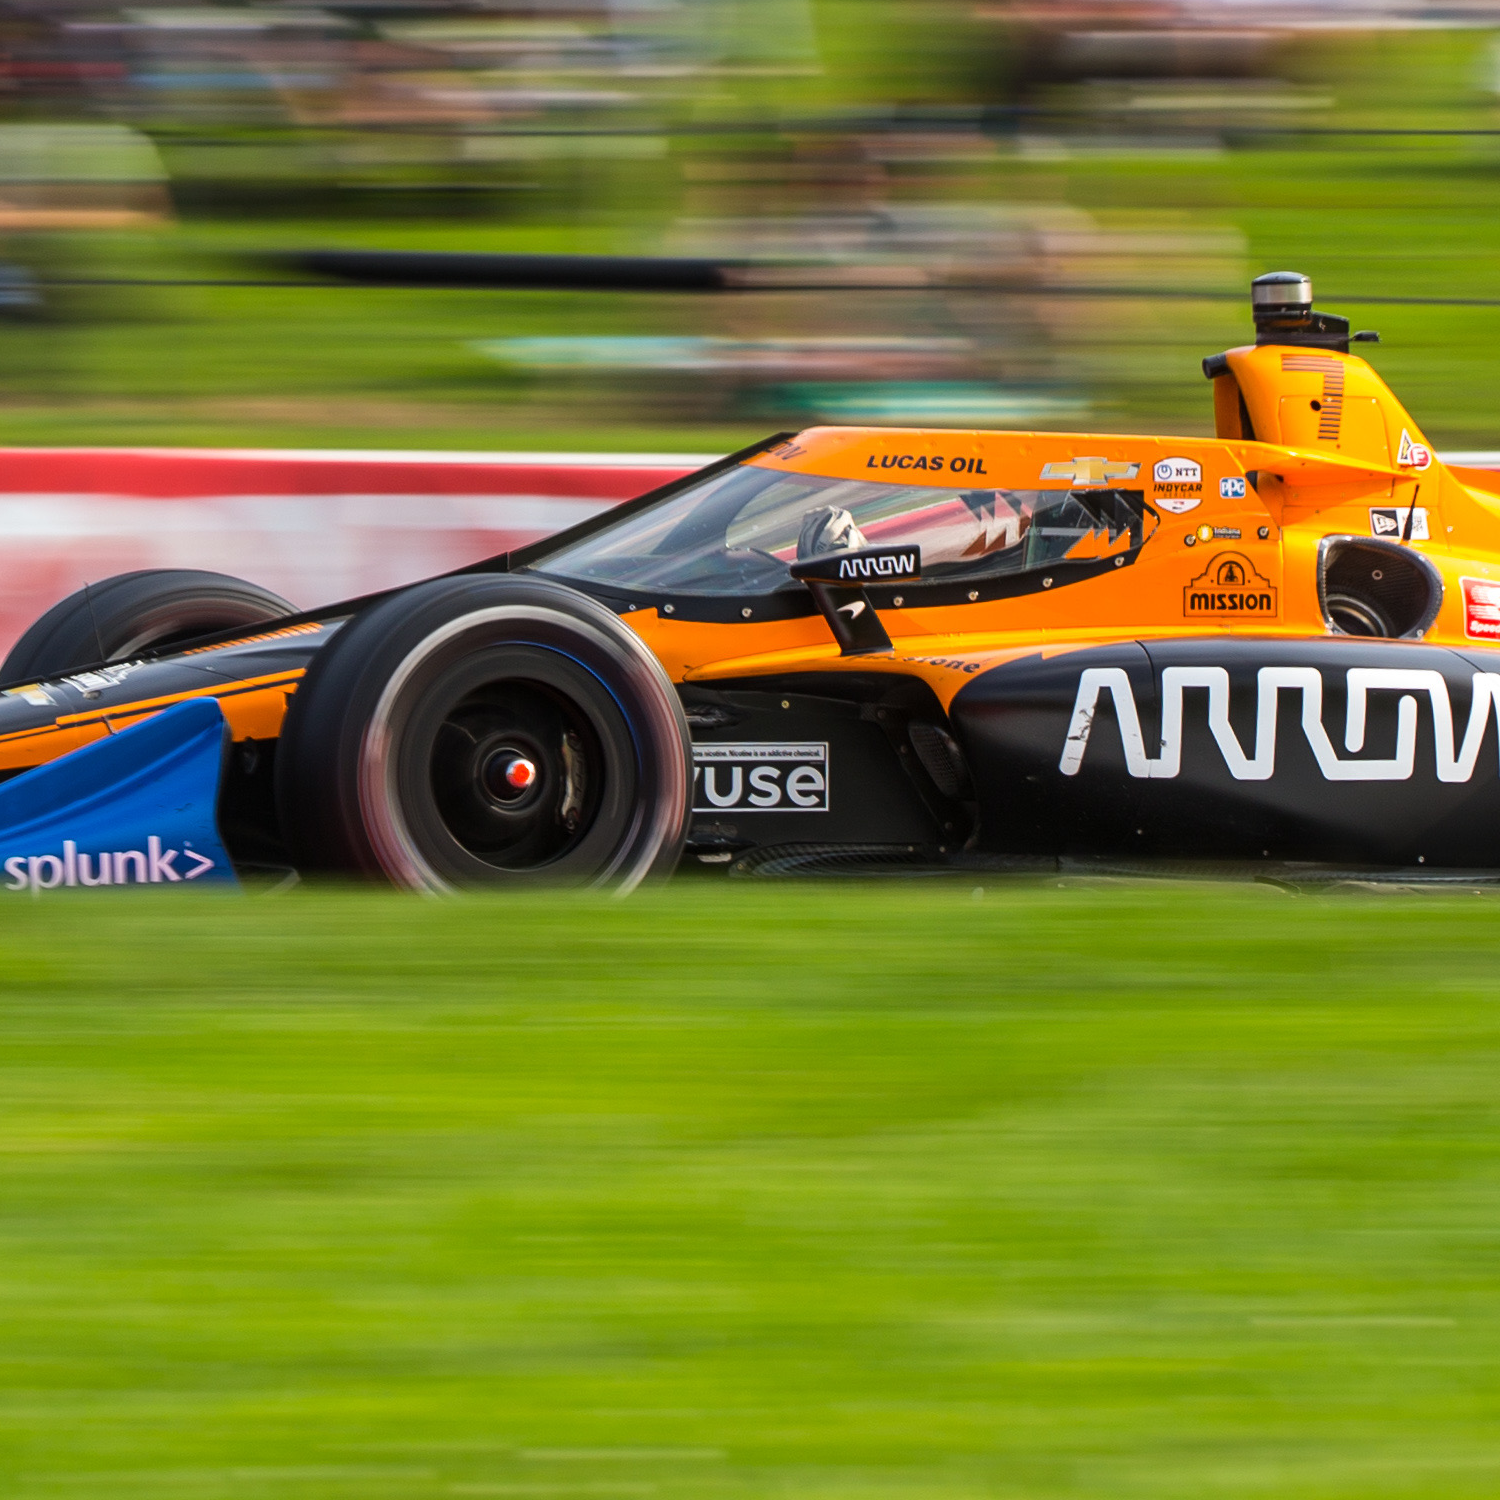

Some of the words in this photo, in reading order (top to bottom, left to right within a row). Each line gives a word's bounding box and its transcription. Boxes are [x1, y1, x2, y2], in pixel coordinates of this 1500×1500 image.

[1281, 354, 1344, 440] 7
[867, 455, 944, 471] LUCAS
[950, 457, 988, 474] OIL
[1175, 468, 1198, 477] NTT
[1153, 483, 1203, 492] INDYCAR
[1221, 479, 1245, 497] PPG
[839, 553, 915, 579] ARROW
